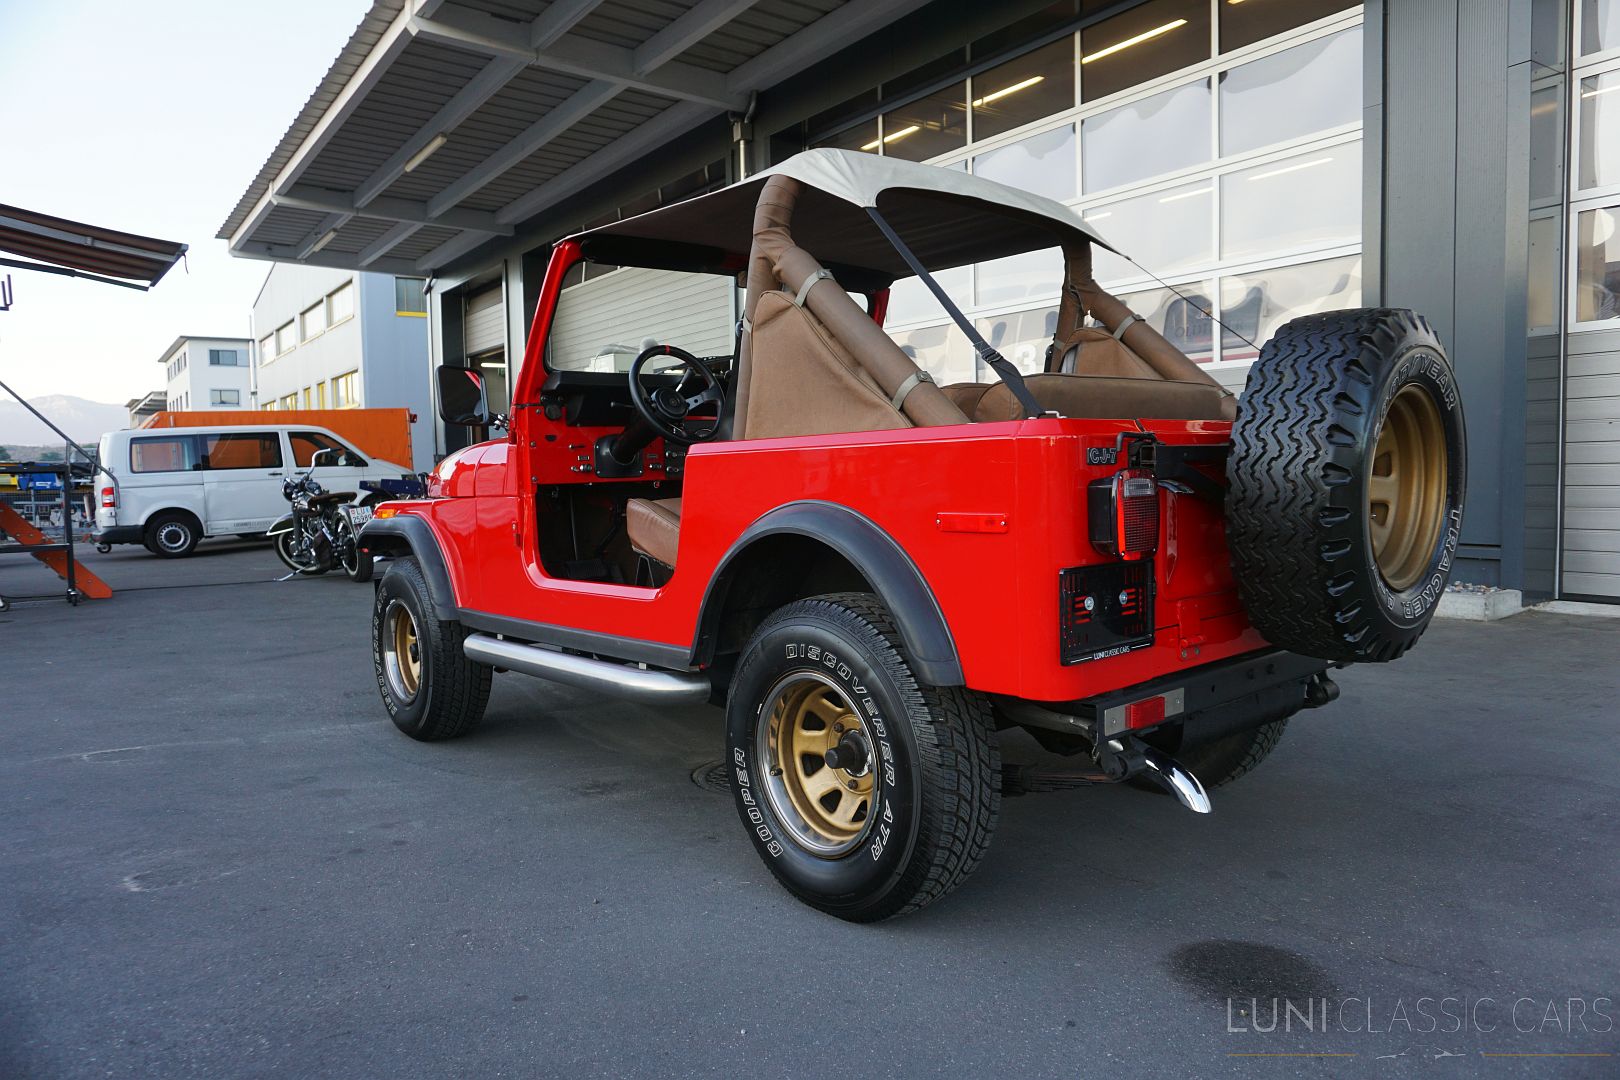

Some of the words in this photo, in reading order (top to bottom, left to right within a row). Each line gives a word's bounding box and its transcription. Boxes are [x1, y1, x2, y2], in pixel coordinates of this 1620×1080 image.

[1089, 447, 1117, 464] CJ-7
[1402, 504, 1463, 619] TRACKER
[734, 747, 784, 858] COOPER
[785, 643, 895, 787] DISCOVERER
[870, 798, 894, 861] ATR
